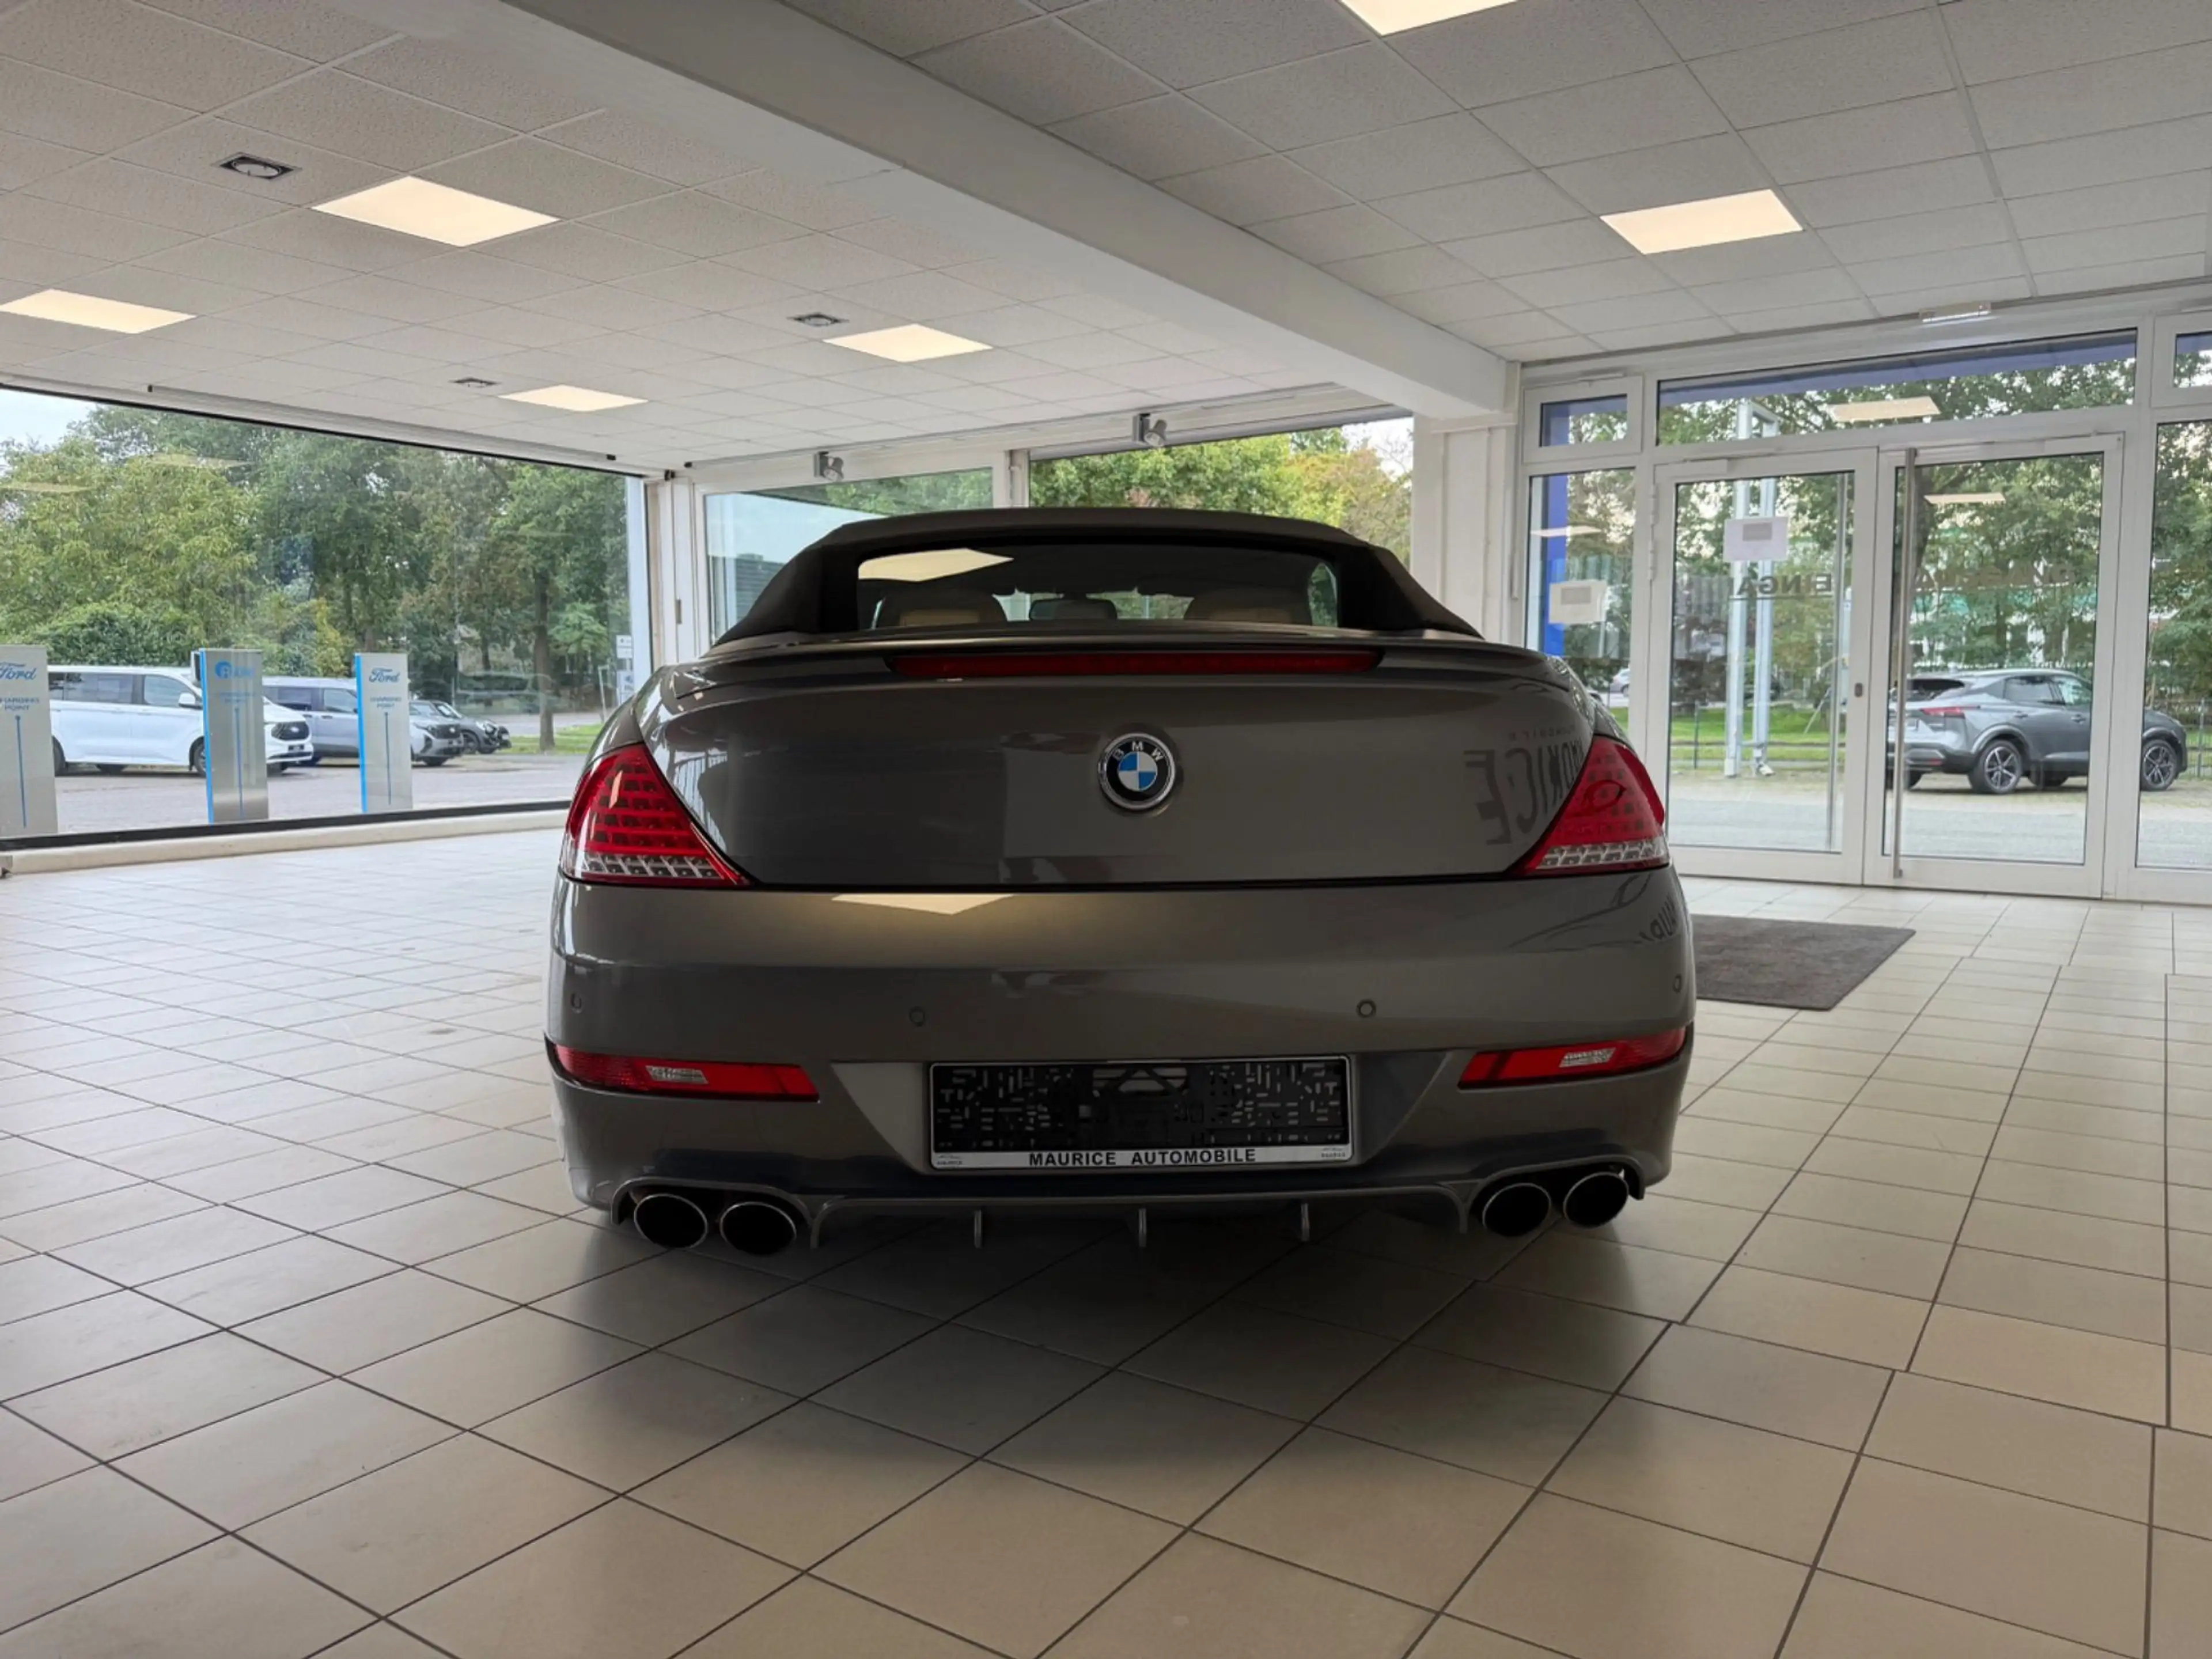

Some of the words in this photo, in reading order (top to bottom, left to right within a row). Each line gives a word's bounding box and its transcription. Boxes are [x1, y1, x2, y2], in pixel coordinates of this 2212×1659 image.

[369, 667, 400, 683] Ford
[1112, 740, 1164, 762] BMW
[1029, 1152, 1116, 1166] MAURICE
[1131, 1149, 1256, 1165] AUTOMOBILE
